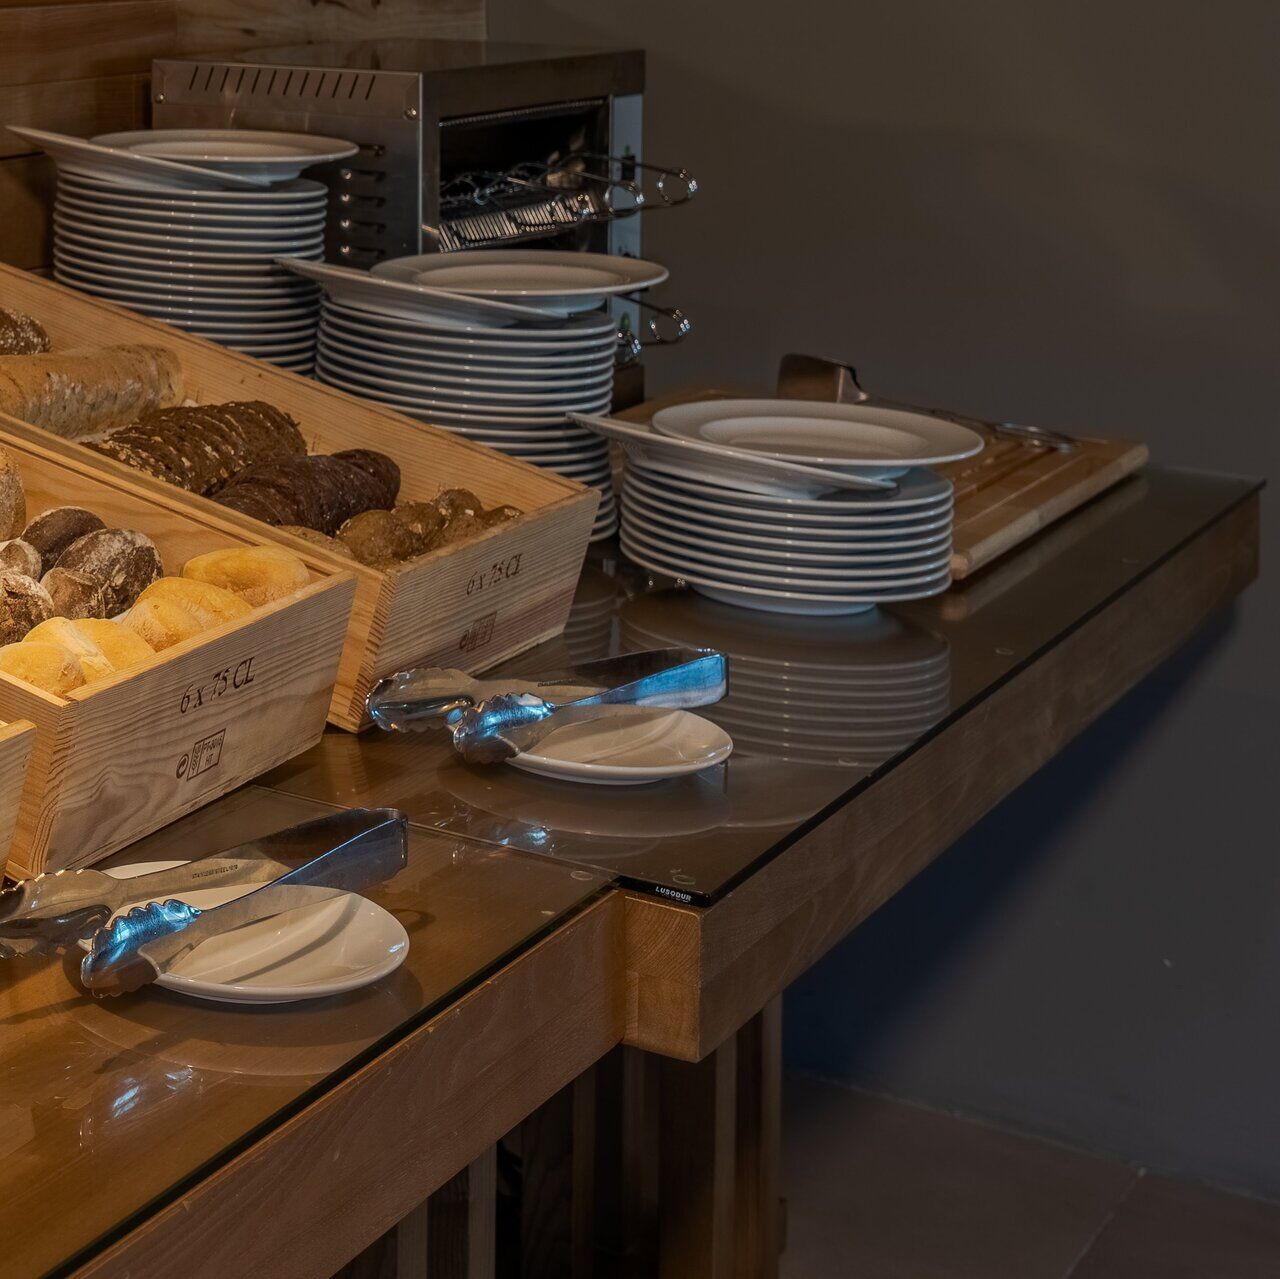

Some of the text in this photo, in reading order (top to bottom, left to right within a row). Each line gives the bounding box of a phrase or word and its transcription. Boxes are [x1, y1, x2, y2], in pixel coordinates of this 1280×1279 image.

[180, 656, 256, 714] 6 x 75 CL
